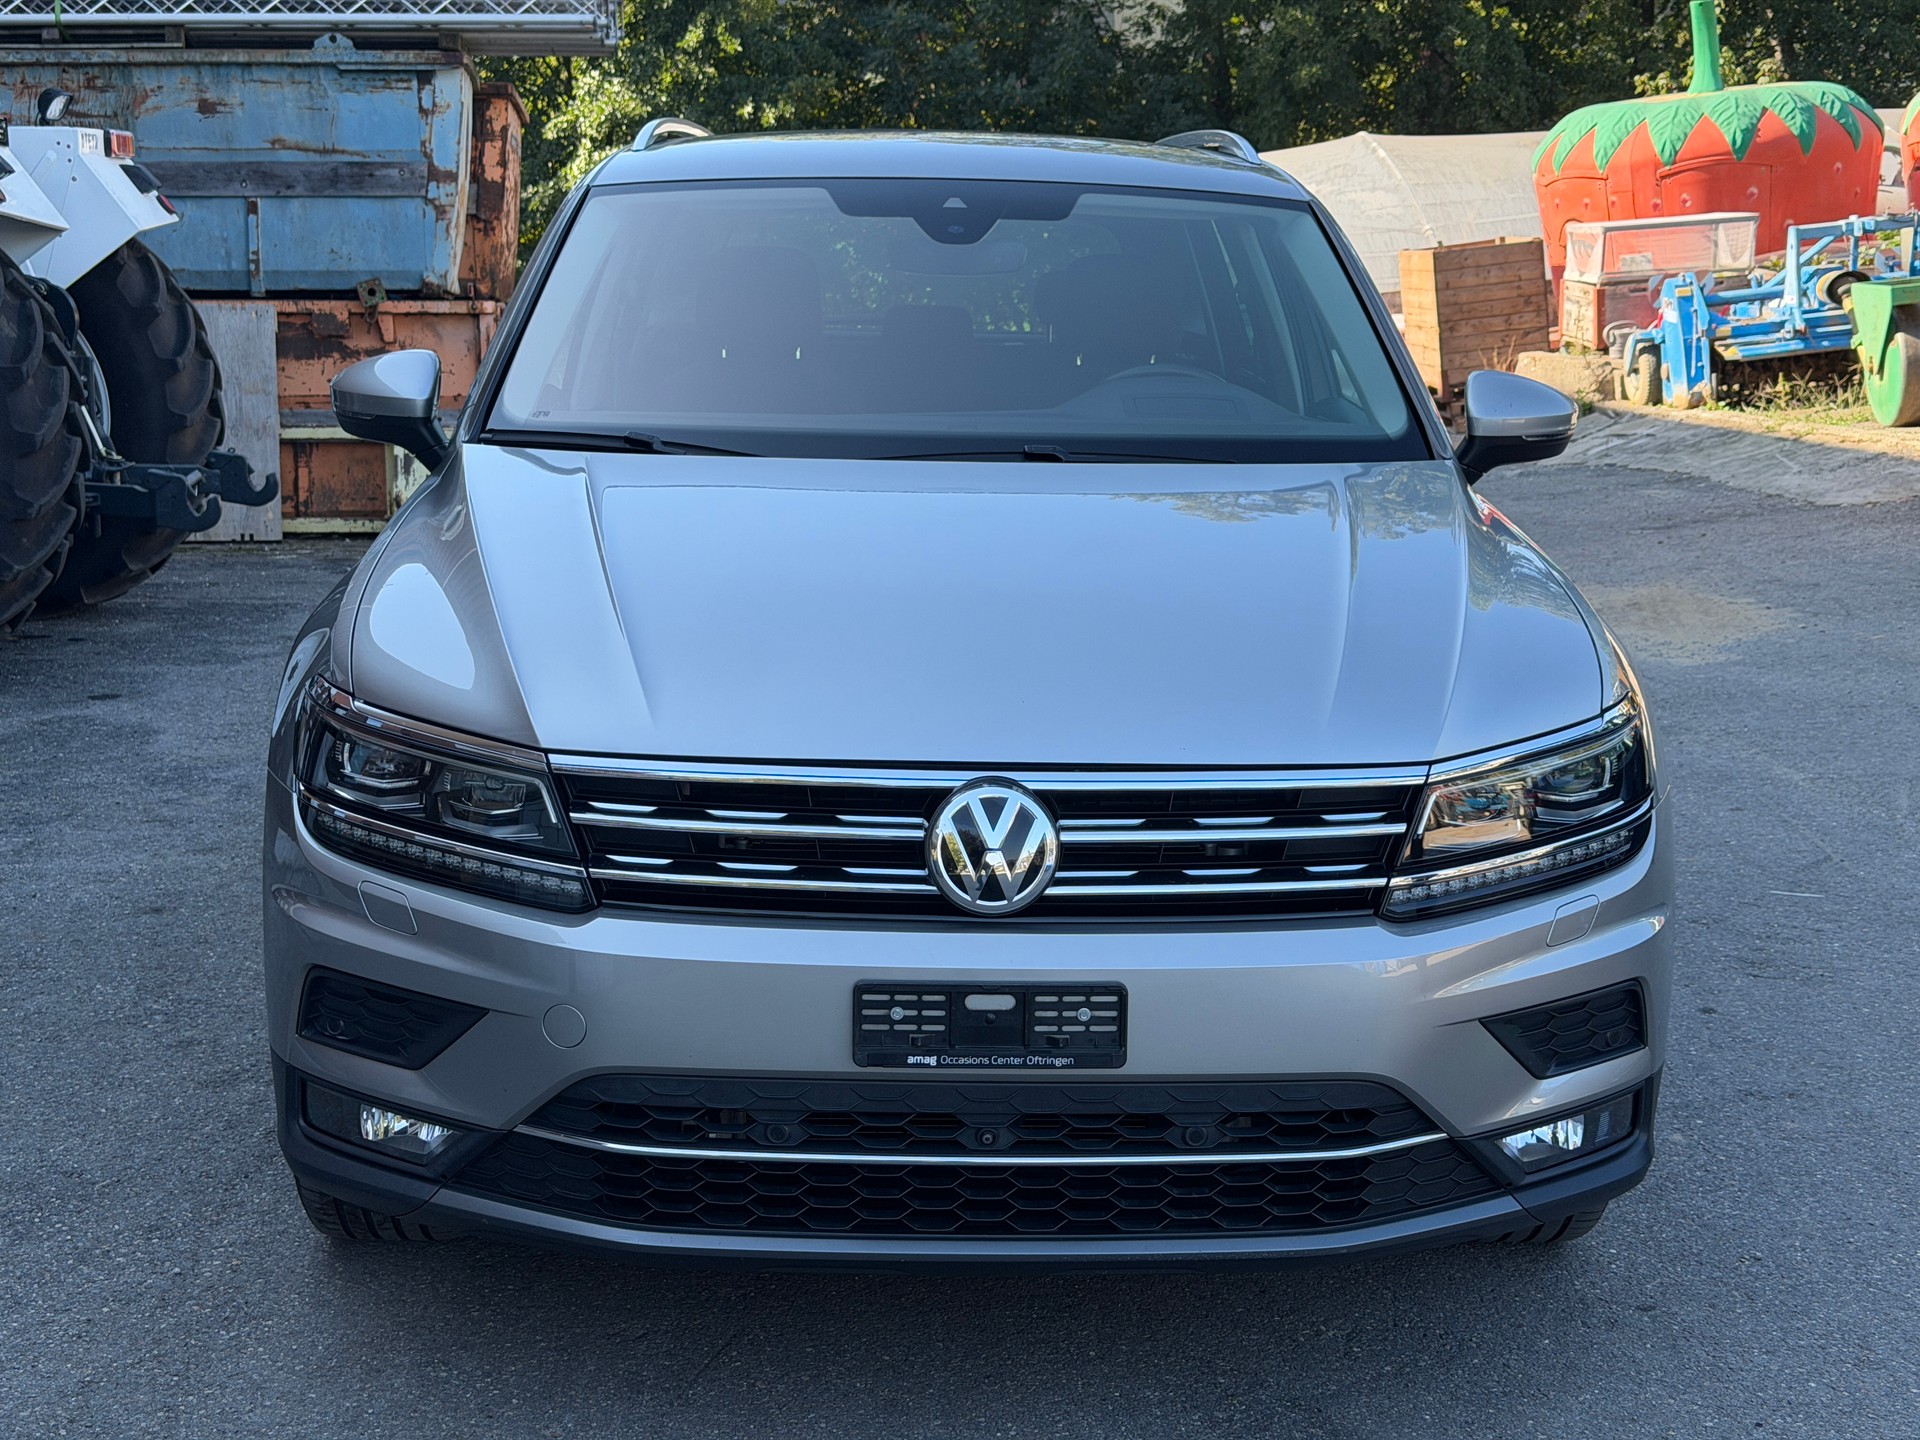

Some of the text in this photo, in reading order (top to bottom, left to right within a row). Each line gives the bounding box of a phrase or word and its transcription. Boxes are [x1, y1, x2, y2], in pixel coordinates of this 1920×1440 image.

[907, 1055, 1074, 1067] amag Occasions Center Oftringen
